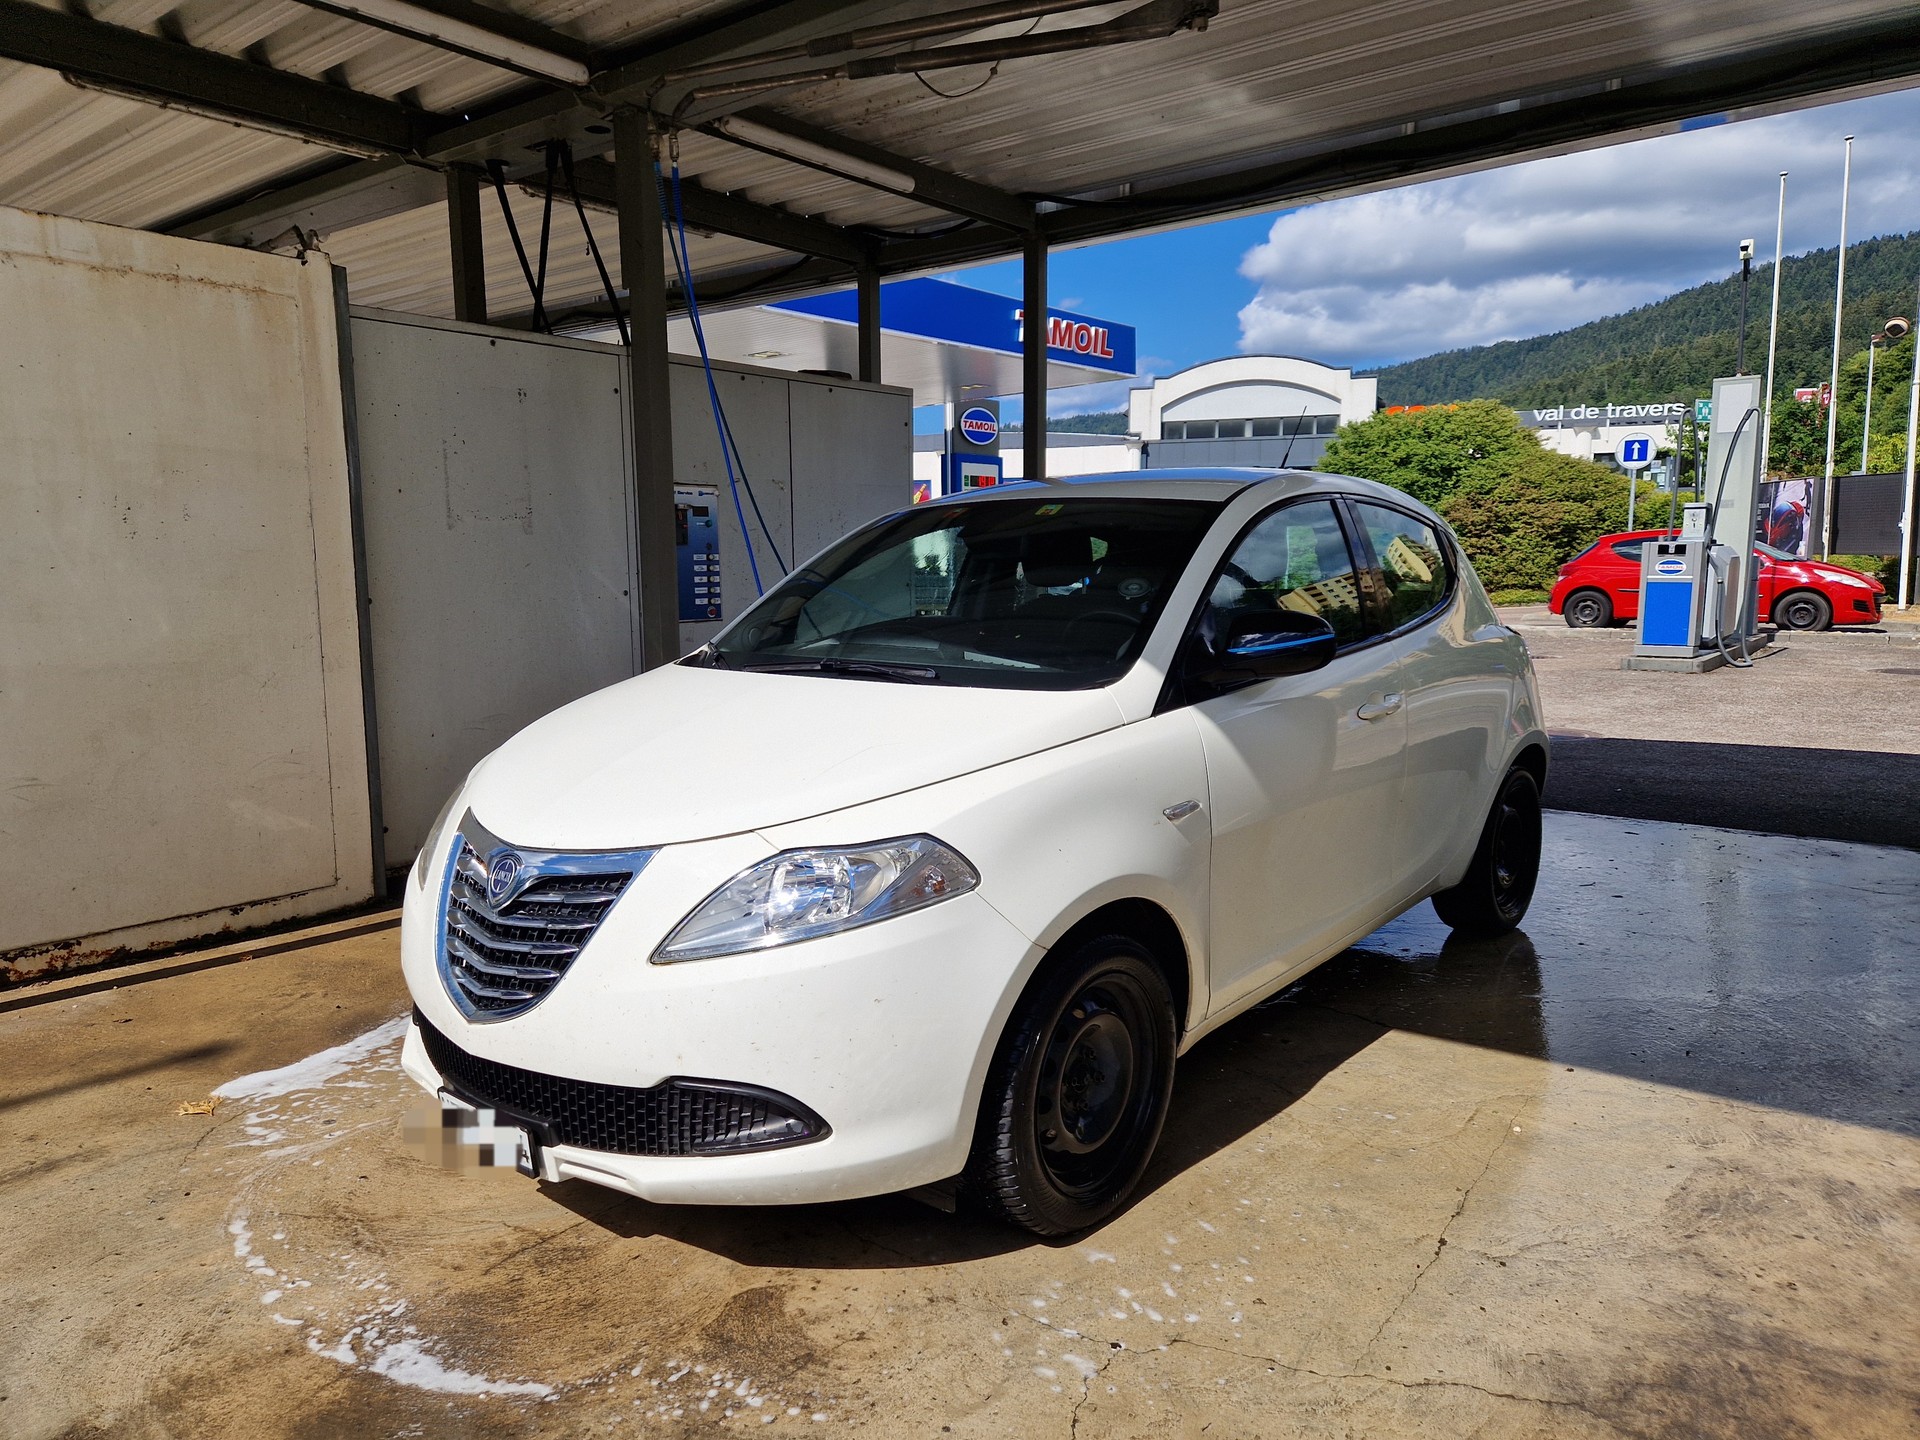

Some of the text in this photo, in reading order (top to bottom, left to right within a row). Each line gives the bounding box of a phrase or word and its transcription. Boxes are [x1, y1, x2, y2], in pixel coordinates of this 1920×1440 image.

[1015, 309, 1114, 359] MOIL
[1533, 402, 1686, 421] val de travers
[963, 420, 997, 432] TAMOIL
